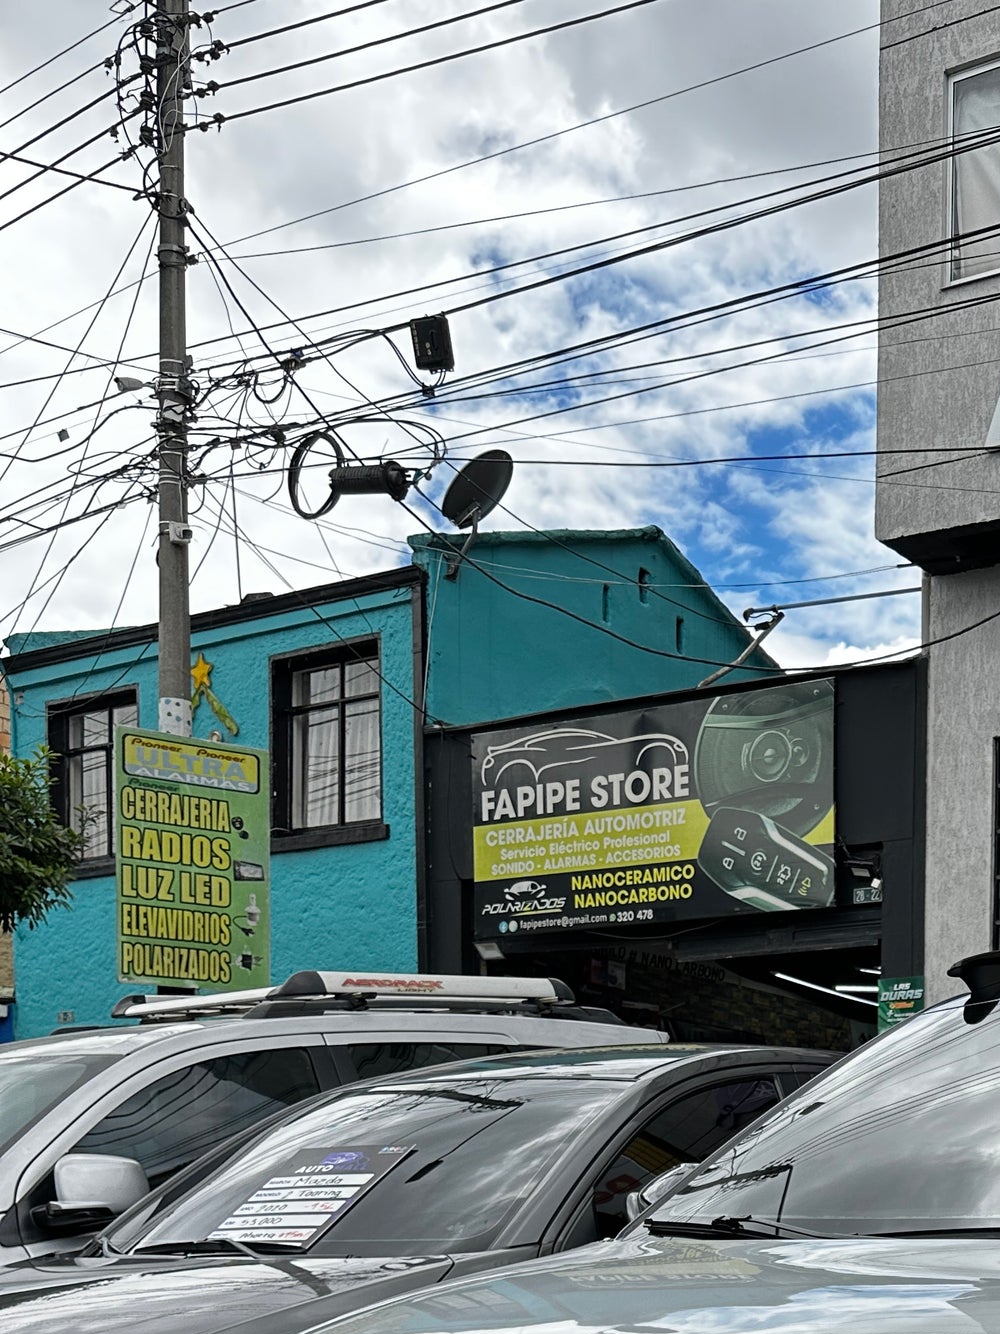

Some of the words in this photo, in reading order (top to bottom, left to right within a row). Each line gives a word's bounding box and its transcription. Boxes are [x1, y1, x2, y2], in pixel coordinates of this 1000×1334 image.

[131, 737, 182, 752] Pioneer
[196, 748, 246, 763] Pioneer
[136, 746, 245, 780] ULTRA
[134, 766, 250, 792] ALARMAS
[481, 779, 580, 821] FAPIPE
[590, 764, 690, 808] STORE
[121, 785, 231, 833] CERRAJERIA
[485, 816, 579, 847] CERRAJERÍA
[584, 807, 686, 836] AUTOMOTRIZ
[121, 824, 231, 871] RADIOS
[491, 859, 535, 876] SONIDO
[543, 853, 596, 871] ALARMAS
[605, 844, 681, 864] ACCESORIOS
[500, 846, 546, 861] Servicio
[550, 837, 600, 856] Eléctrico
[603, 830, 670, 850] Profesional
[121, 862, 175, 903] LUZ
[179, 870, 231, 909] LED
[571, 864, 695, 891] NANOCERAMICO
[481, 897, 567, 916] POLARIZADOS
[574, 883, 693, 909] NANOCARBONO
[121, 902, 231, 946] ELEVAVIDRIOS
[520, 914, 608, 930] fapipestore@gmail.com
[616, 910, 635, 923] 320
[636, 909, 654, 921] 478
[121, 941, 231, 984] POLARIZADOS
[880, 988, 924, 1002] DURAS
[893, 983, 912, 991] LAS
